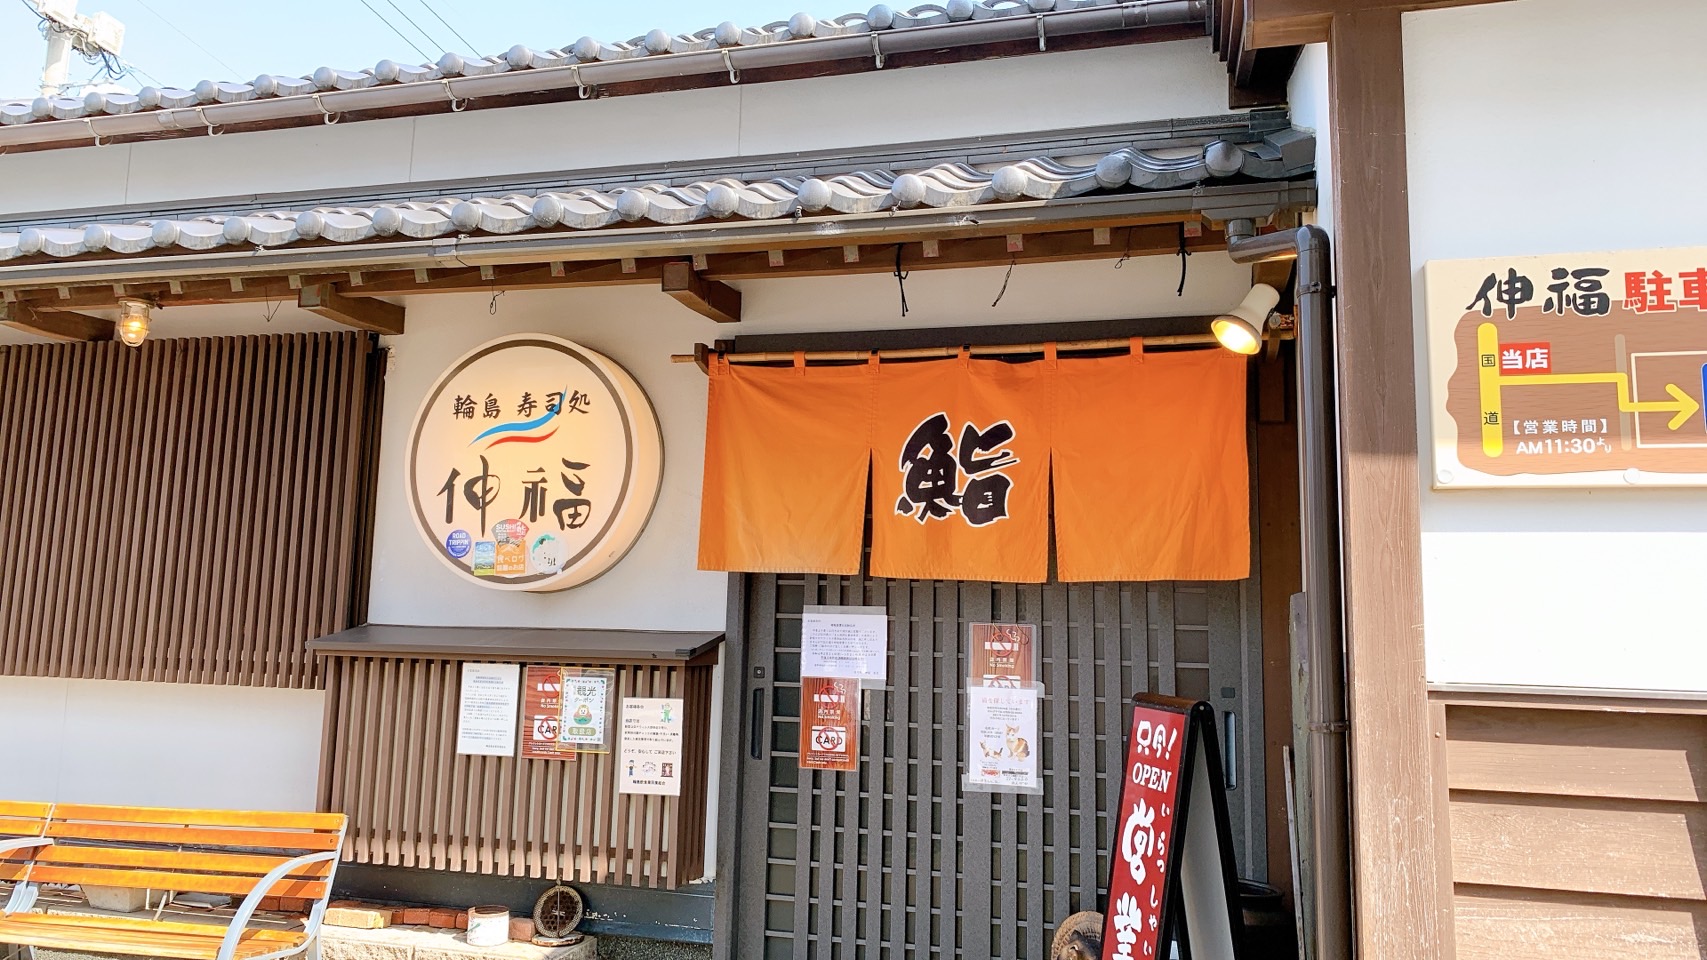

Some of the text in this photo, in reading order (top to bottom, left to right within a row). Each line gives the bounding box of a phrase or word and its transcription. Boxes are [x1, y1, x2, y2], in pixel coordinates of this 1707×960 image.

[1465, 267, 1611, 320] 伸福
[1501, 348, 1549, 369] 当店
[452, 389, 591, 420] 輪島 寿司処
[1512, 419, 1608, 436] 【営業時間】
[894, 411, 1020, 528] 鮨
[436, 455, 591, 538] 伸福
[497, 555, 524, 564] 食べログ
[577, 685, 597, 697] 観光
[815, 735, 843, 745] CARD
[1132, 762, 1173, 794] OPEN
